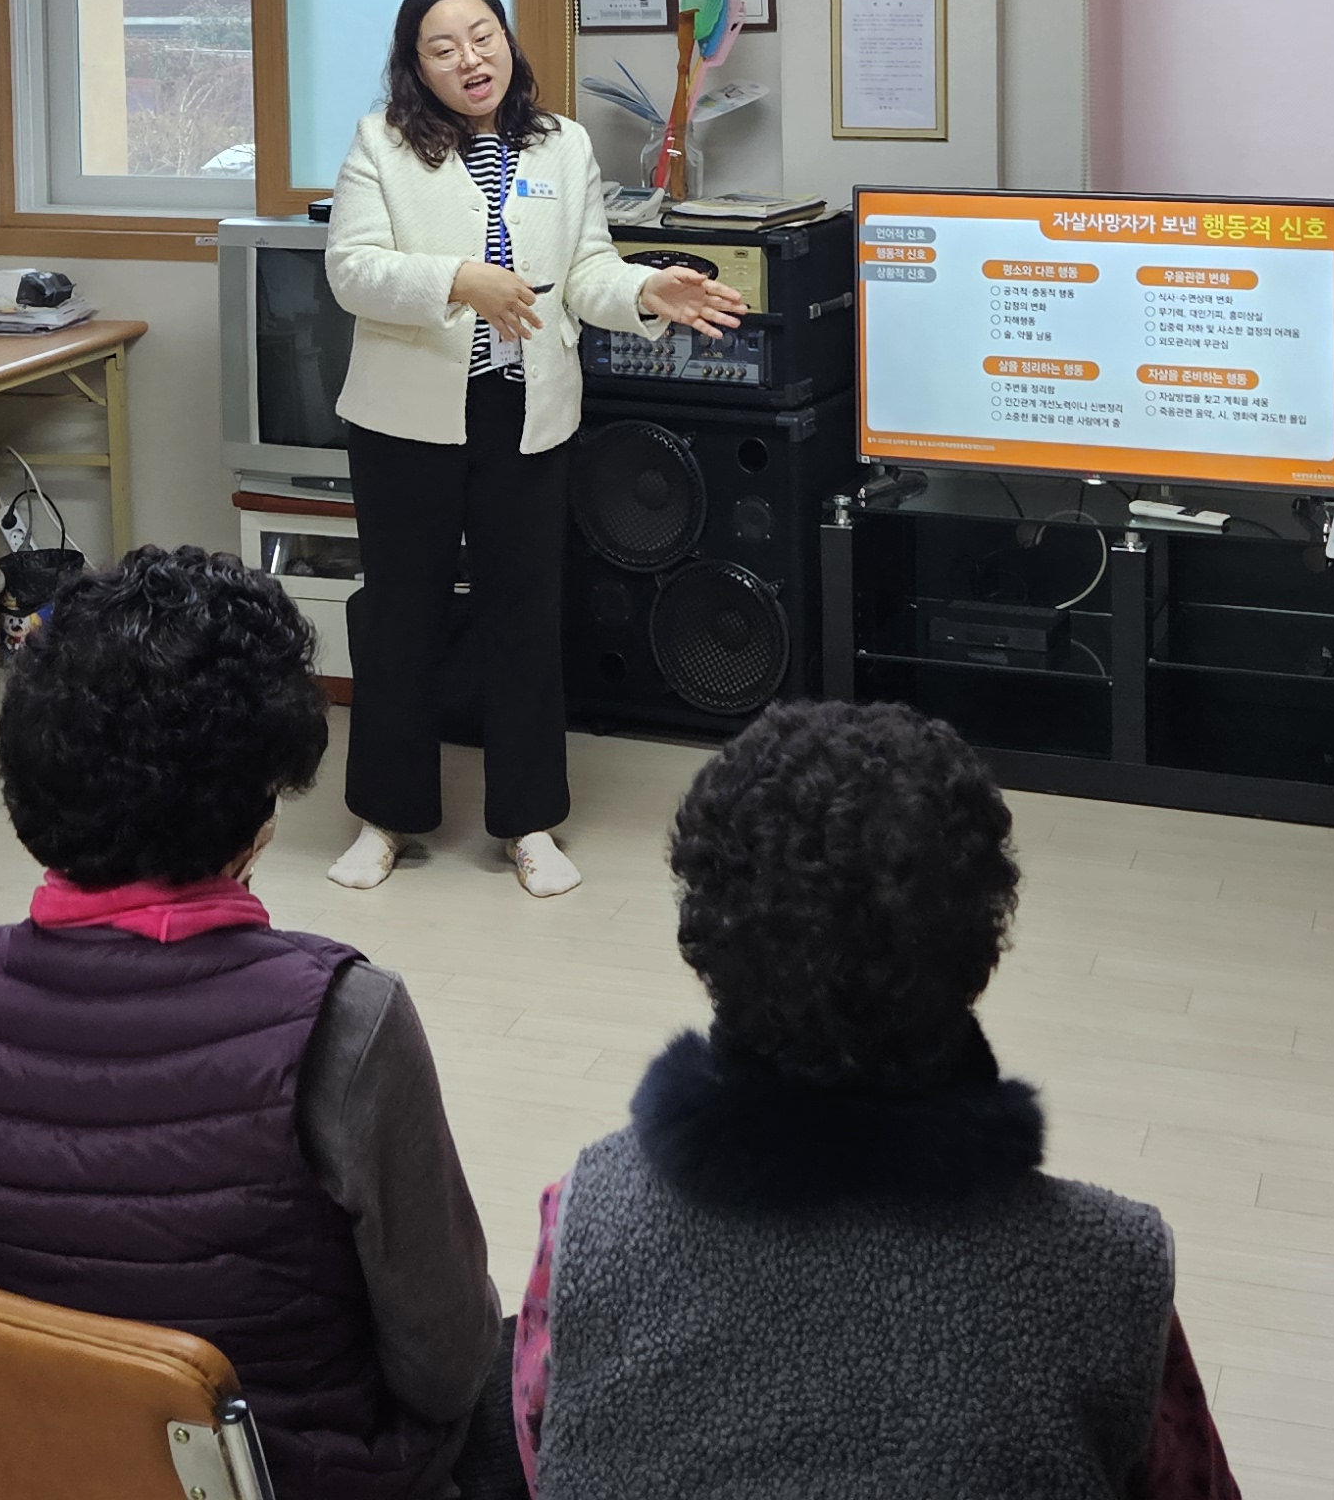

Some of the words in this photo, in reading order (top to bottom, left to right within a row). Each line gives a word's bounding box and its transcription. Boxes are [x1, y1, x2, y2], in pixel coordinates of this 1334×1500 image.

[875, 227, 904, 240] 언어적
[906, 228, 926, 240] 신호
[1052, 212, 1157, 235] 자살사망자가
[1161, 217, 1197, 236] 보낸
[1202, 213, 1271, 240] 행동적
[1279, 217, 1328, 241] 신호
[876, 247, 904, 260] 행동적
[906, 248, 926, 260] 신호
[876, 266, 904, 280] 상황적
[906, 268, 926, 280] 신호
[1002, 264, 1032, 277] 평소와
[1034, 266, 1055, 278] 다른
[1057, 267, 1078, 279] 행동
[1163, 271, 1206, 285] 우울관련
[1208, 273, 1231, 286] 변화
[1058, 288, 1075, 299] 행동
[1215, 295, 1234, 305] 변화
[1030, 303, 1047, 312] 변화
[1003, 315, 1036, 326] 자해행동
[1229, 310, 1263, 322] 흥미상실
[1016, 331, 1033, 341] 약물
[1187, 323, 1203, 333] 저하
[1205, 325, 1215, 334] 및
[1218, 324, 1243, 336] 사소한
[1246, 326, 1272, 338] 결정의
[1275, 328, 1300, 339] 어려움
[1158, 336, 1201, 349] 외모관리에
[1203, 339, 1229, 350] 무관심
[998, 361, 1018, 373] 삶을
[1021, 363, 1061, 376] 정리하는
[1064, 365, 1084, 377] 행동
[1148, 368, 1179, 382] 자살을
[1182, 370, 1223, 384] 준비하는
[1226, 373, 1247, 386] 행동
[1004, 383, 1028, 393] 주변을
[1030, 384, 1055, 395] 정리함
[1004, 397, 1037, 408] 인간관계
[1039, 399, 1088, 411] 개선노력이나
[1090, 402, 1123, 414] 신변정리
[1159, 392, 1201, 404] 자살방법을
[1204, 395, 1221, 405] 찾고
[1224, 396, 1249, 407] 계획을
[1004, 412, 1028, 423] 소중한
[1031, 414, 1055, 425] 물건을
[1058, 415, 1074, 426] 다른
[1077, 416, 1110, 428] 사람에게
[1159, 406, 1193, 418] 죽음관련
[1233, 411, 1258, 422] 영화에
[1261, 413, 1287, 424] 과도한
